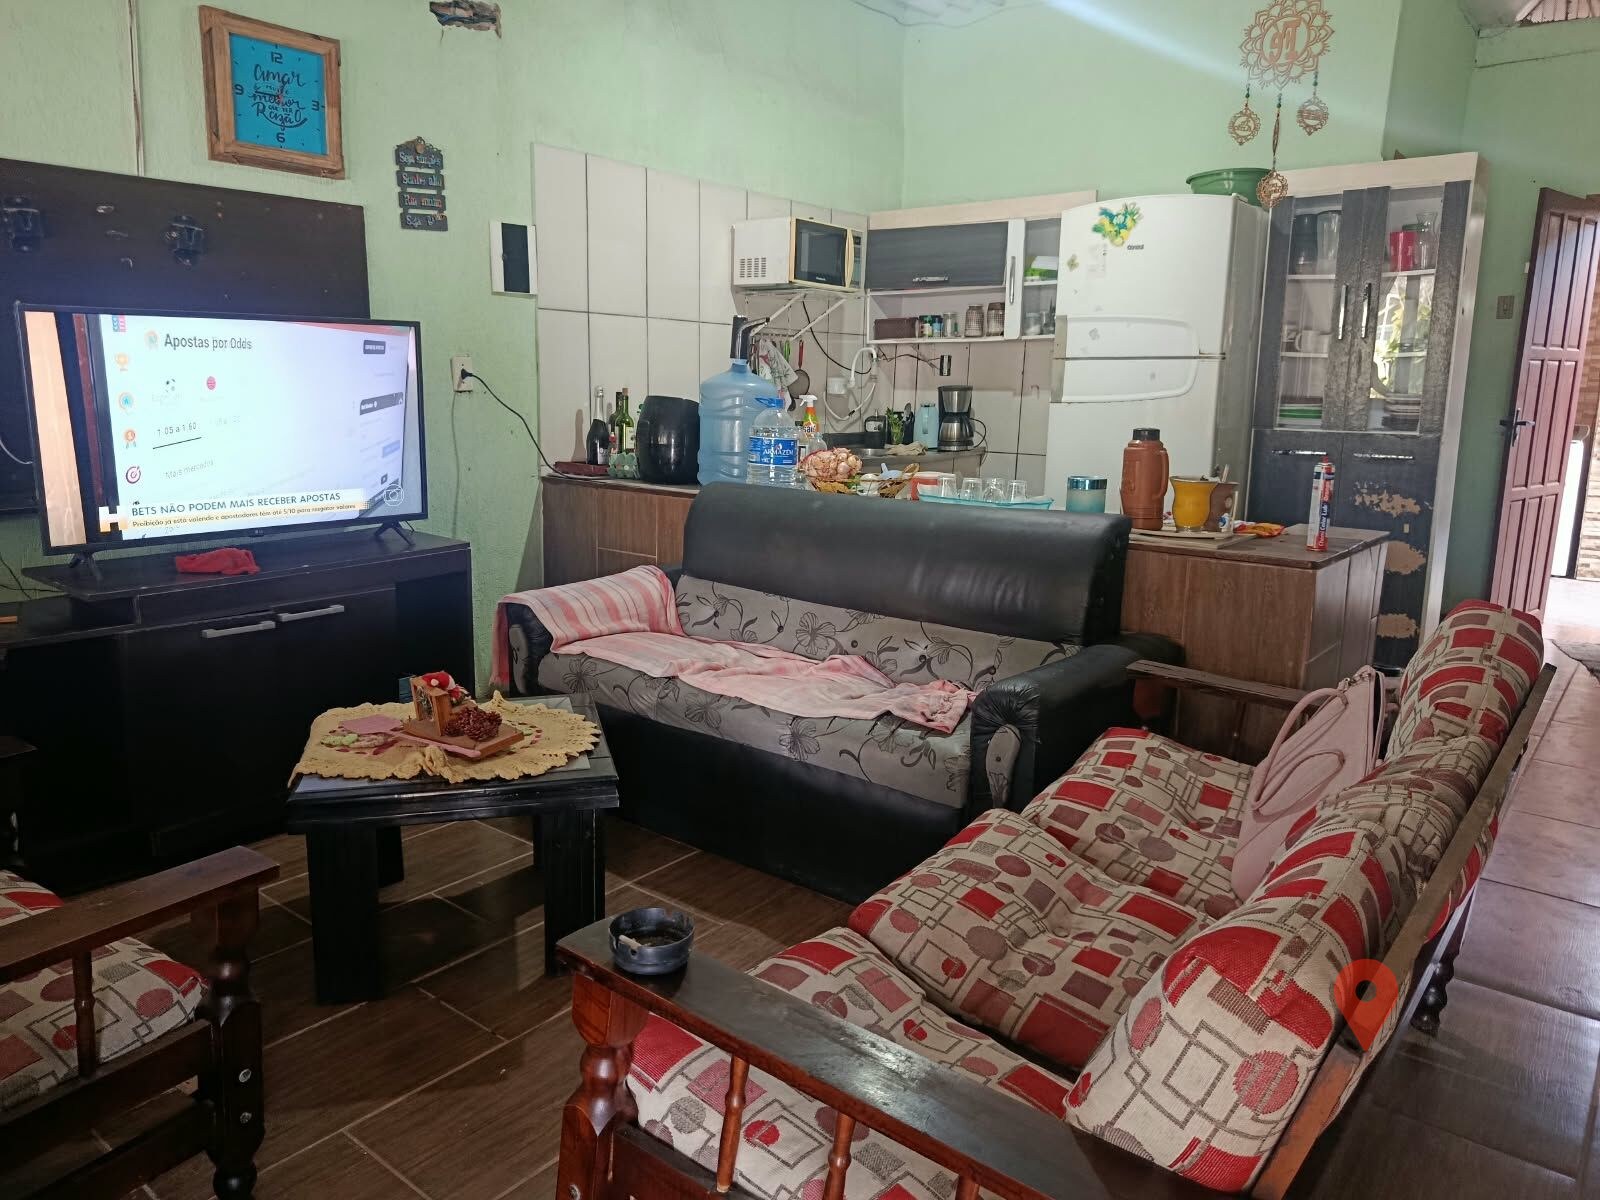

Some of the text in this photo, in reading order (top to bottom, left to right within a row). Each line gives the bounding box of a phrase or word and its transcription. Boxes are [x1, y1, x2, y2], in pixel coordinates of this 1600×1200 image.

[271, 52, 283, 64] 12
[234, 84, 244, 95] 9
[312, 100, 320, 111] 3
[277, 132, 285, 143] 6
[165, 334, 252, 351] Apostas por Odds
[132, 492, 341, 516] BETS NÃO PODEM MAIS RECEBER APOSTAS
[132, 520, 163, 528] Proibição
[189, 514, 214, 523] valendo
[221, 511, 258, 519] apostadores
